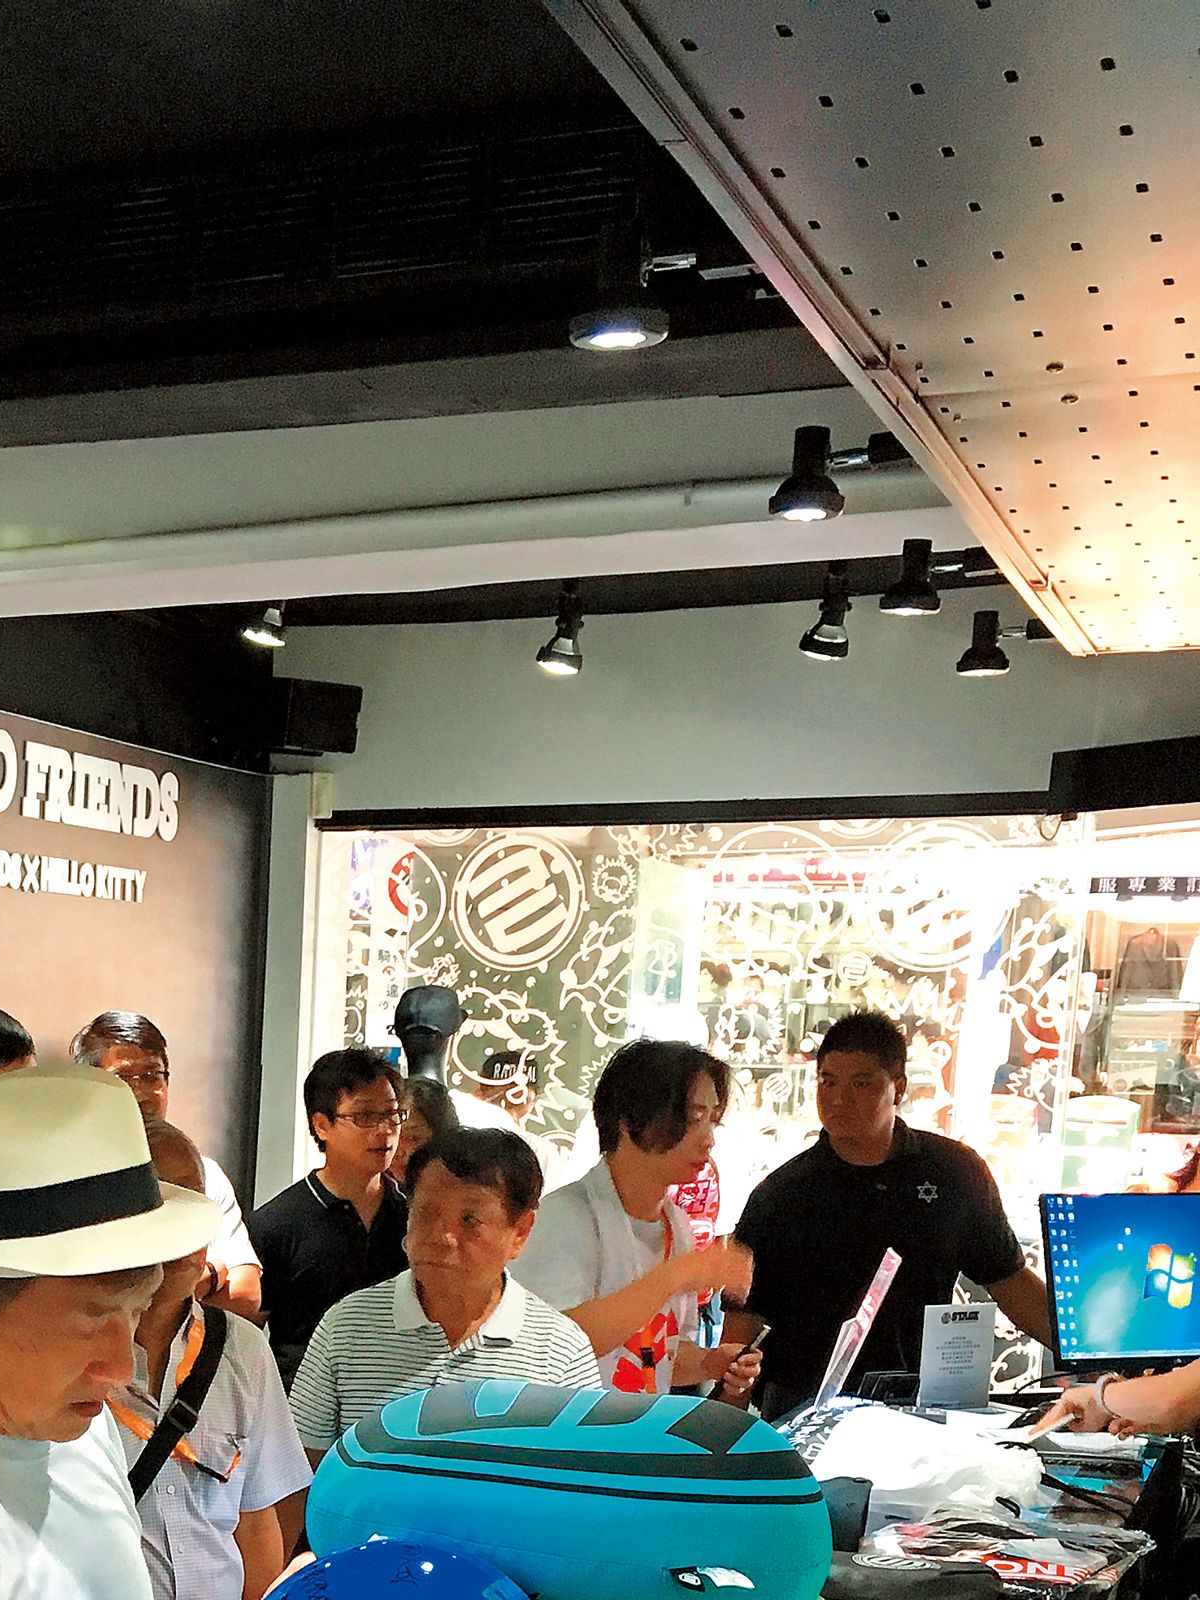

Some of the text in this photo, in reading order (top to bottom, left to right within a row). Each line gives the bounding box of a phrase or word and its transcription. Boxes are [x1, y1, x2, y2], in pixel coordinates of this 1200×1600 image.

[20, 740, 179, 842] FRIENDS
[41, 855, 95, 898] HELLO
[95, 863, 148, 904] KITTY
